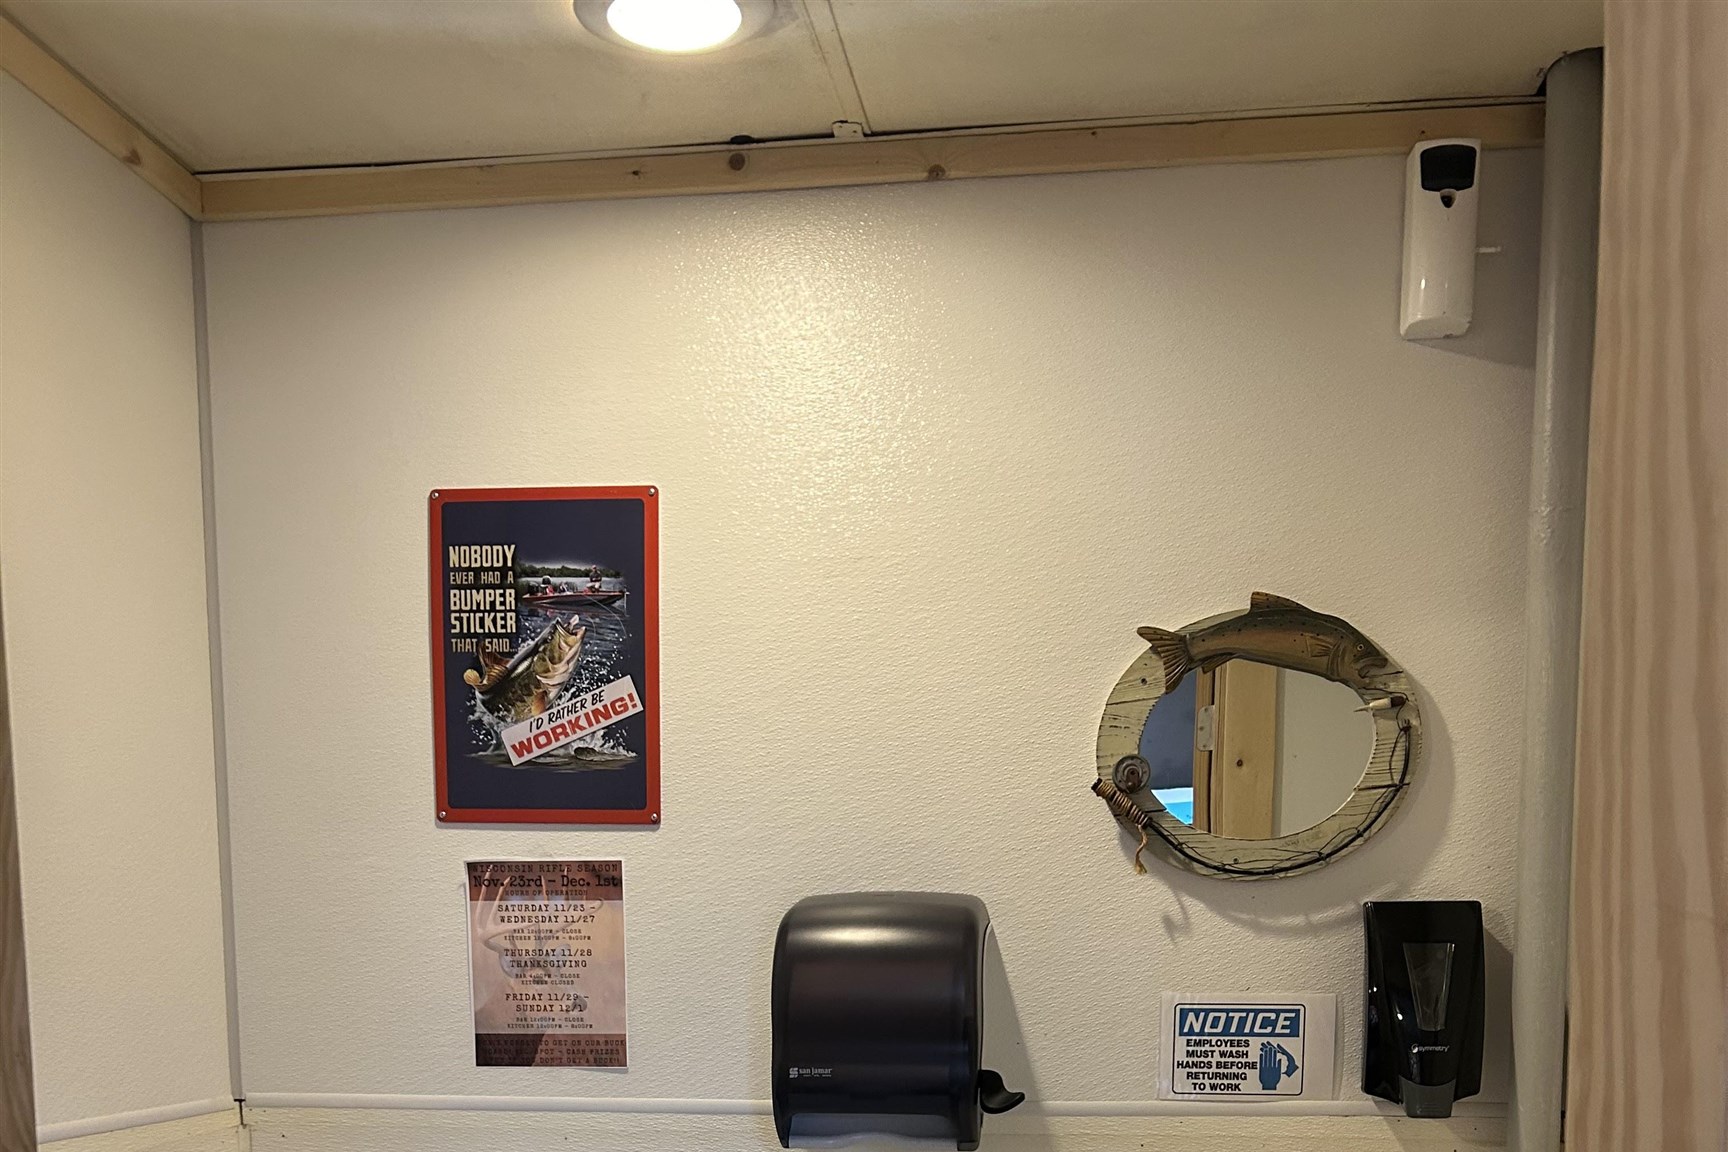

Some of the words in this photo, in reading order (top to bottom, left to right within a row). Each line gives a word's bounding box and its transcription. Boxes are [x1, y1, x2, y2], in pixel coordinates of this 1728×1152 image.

[449, 545, 515, 567] NOBODY
[450, 571, 474, 584] EVER
[481, 571, 500, 584] HAD
[507, 571, 514, 584] A
[450, 589, 515, 610] BUMPER
[451, 612, 516, 633] STICKER
[451, 638, 477, 653] THAT
[485, 638, 517, 653] SAID...
[529, 717, 544, 733] I'D
[548, 699, 587, 725] RATHER
[591, 690, 605, 706] BE
[511, 692, 638, 759] WORKING!
[473, 864, 533, 873] WISCONSIN
[539, 864, 572, 873] RIFLE
[577, 864, 618, 873] SEASON
[474, 875, 504, 887] Nov.
[509, 875, 543, 887] 23rd
[561, 875, 590, 887] Dec.
[595, 875, 620, 887] 1st
[498, 904, 550, 912] SATURDAY
[554, 904, 585, 912] 11/23
[499, 915, 559, 923] WEDNESDAY
[563, 915, 595, 923] 11/27
[561, 948, 593, 956] 11/28
[509, 960, 587, 968] THANKSGIVING
[505, 993, 543, 1001] FRIDAY
[547, 993, 578, 1001] 11/29
[516, 1004, 554, 1012] SUNDAY
[559, 1004, 584, 1012] 12/1
[1183, 1012, 1296, 1033] NOTICE
[1186, 1038, 1250, 1048] EMPLOYEES
[1186, 1049, 1216, 1058] MUST
[1219, 1049, 1249, 1059] WASH
[1177, 1060, 1213, 1069] HANDS
[1215, 1060, 1258, 1070] BEFORE
[1186, 1071, 1247, 1081] RETURNING
[1191, 1082, 1206, 1091] TO
[1209, 1083, 1242, 1092] WORK
